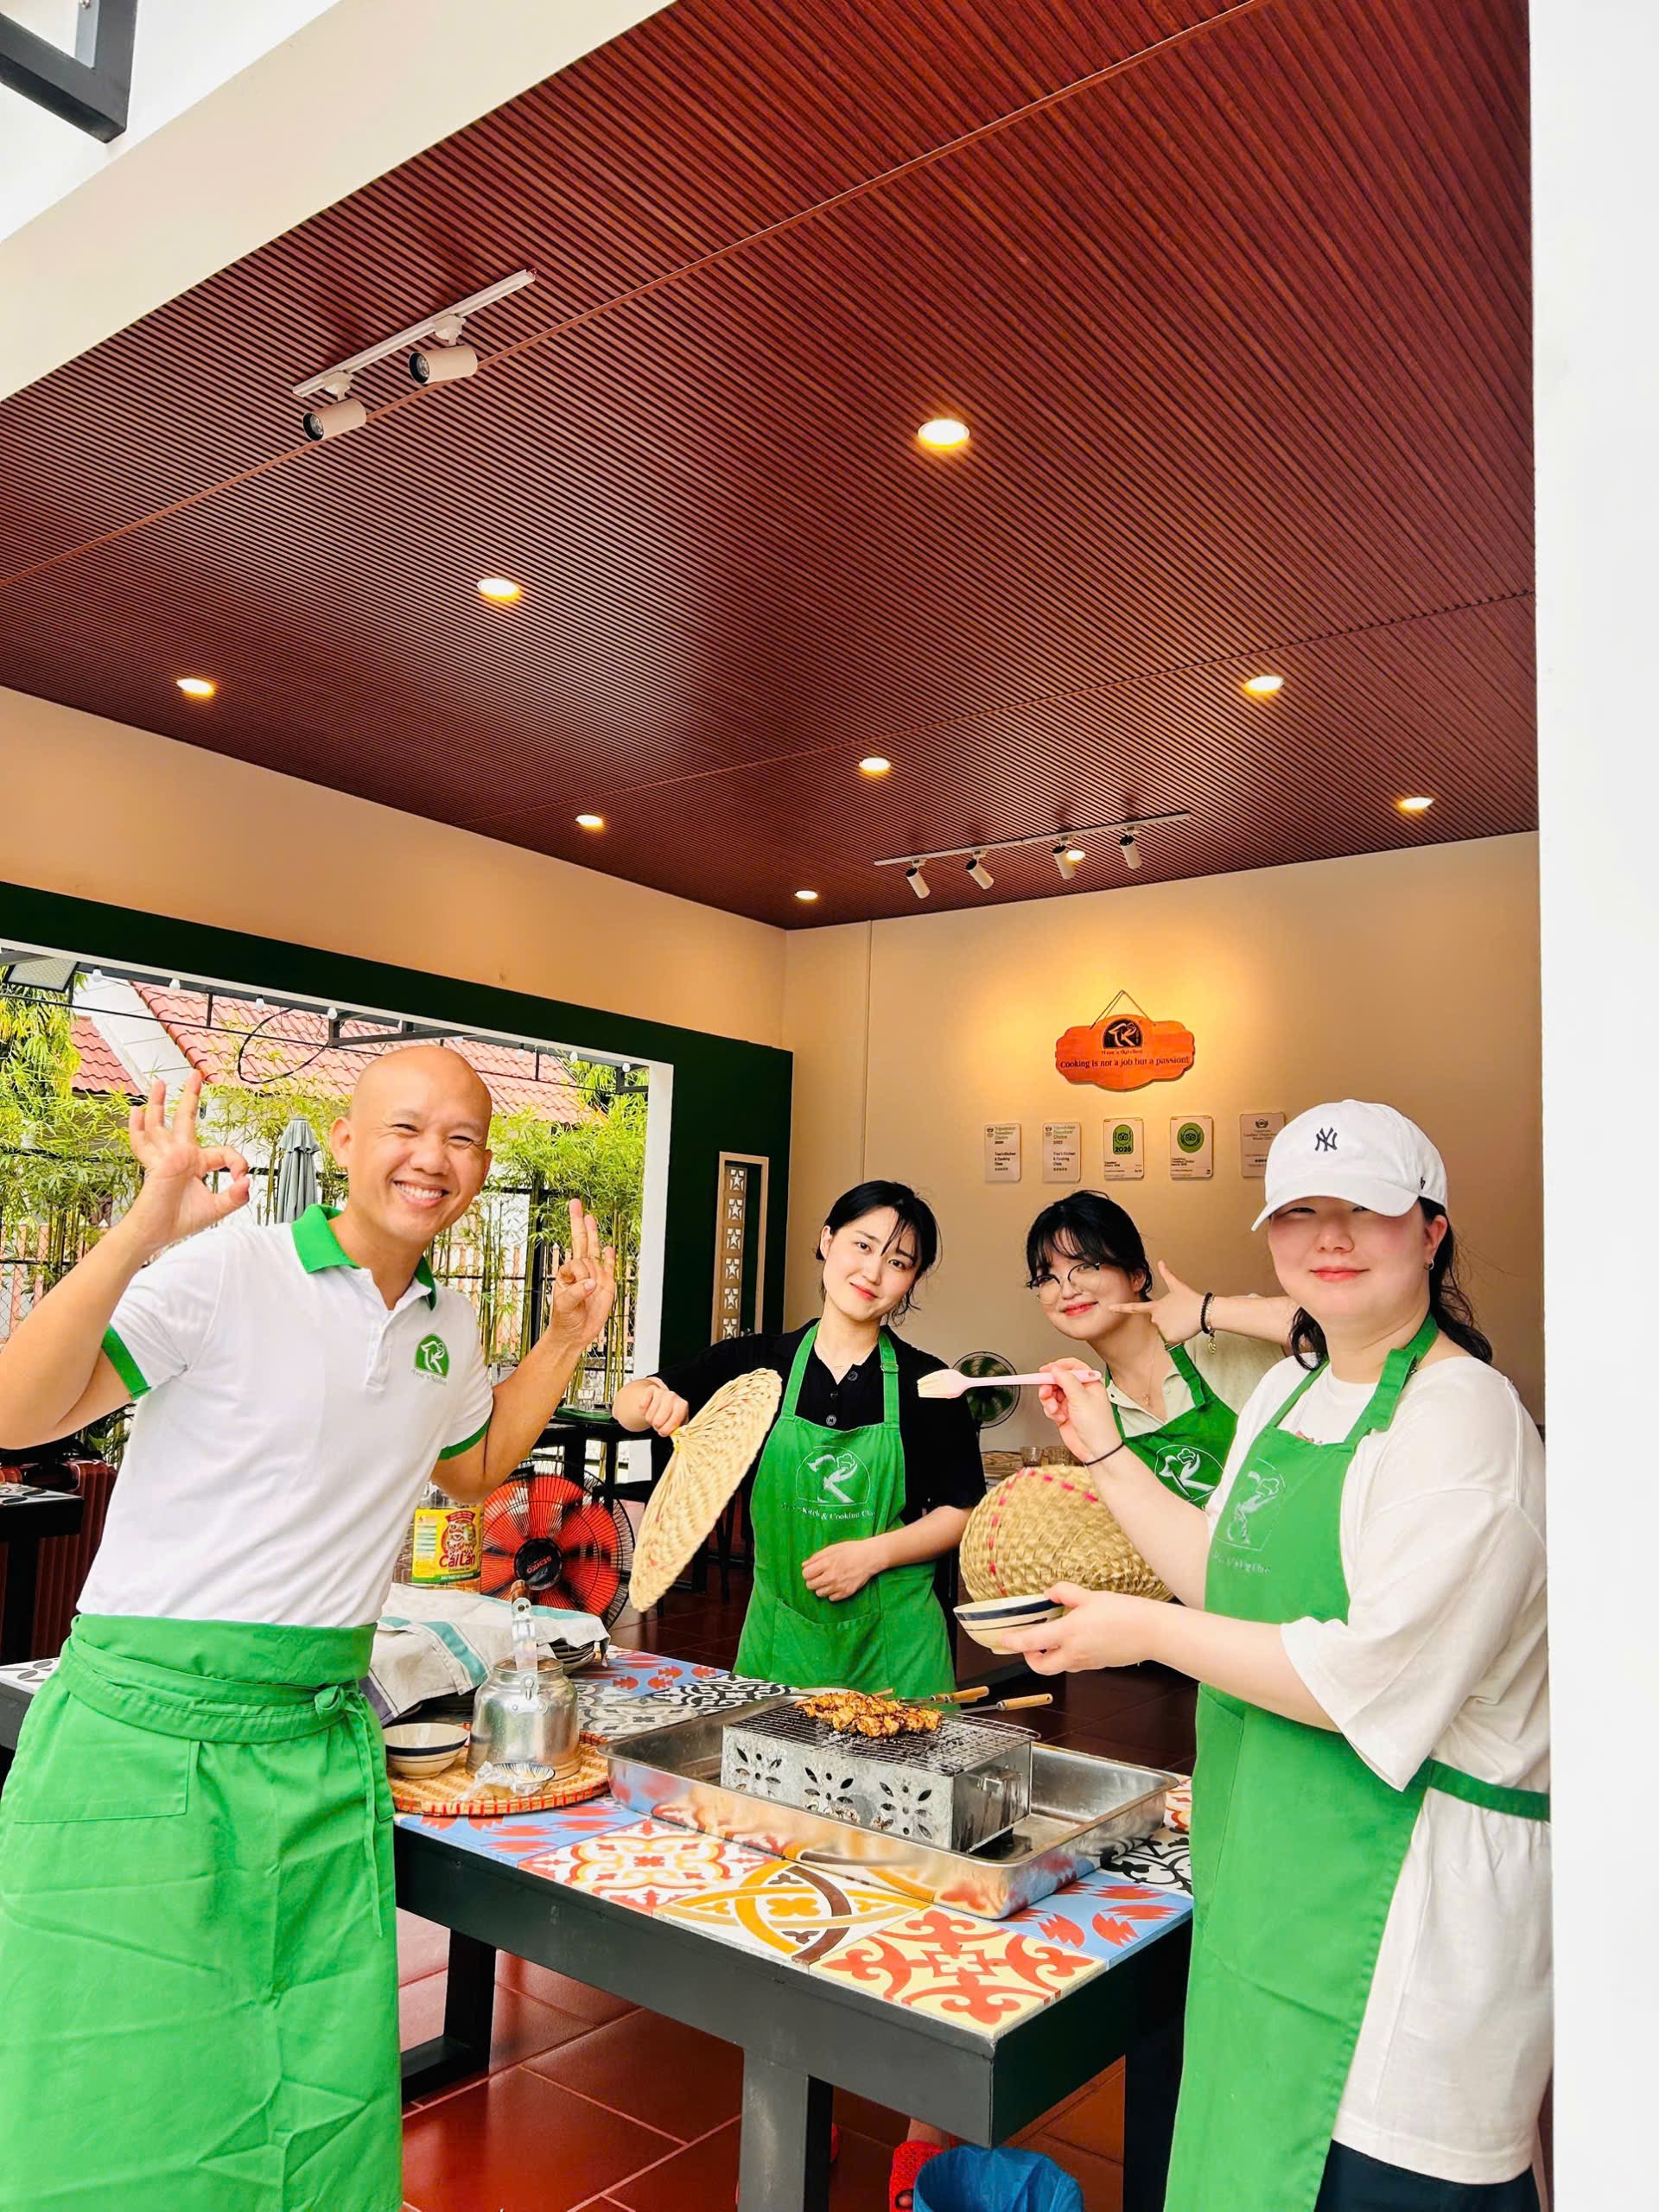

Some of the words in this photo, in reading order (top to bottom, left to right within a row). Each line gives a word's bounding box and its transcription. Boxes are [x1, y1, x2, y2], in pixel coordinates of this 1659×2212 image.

[1060, 1059, 1090, 1069] Cooking
[1120, 1058, 1133, 1068] job
[1156, 1056, 1189, 1066] passion!
[1314, 1127, 1338, 1152] NY
[802, 1507, 820, 1517] Kitch
[821, 1512, 829, 1521] &
